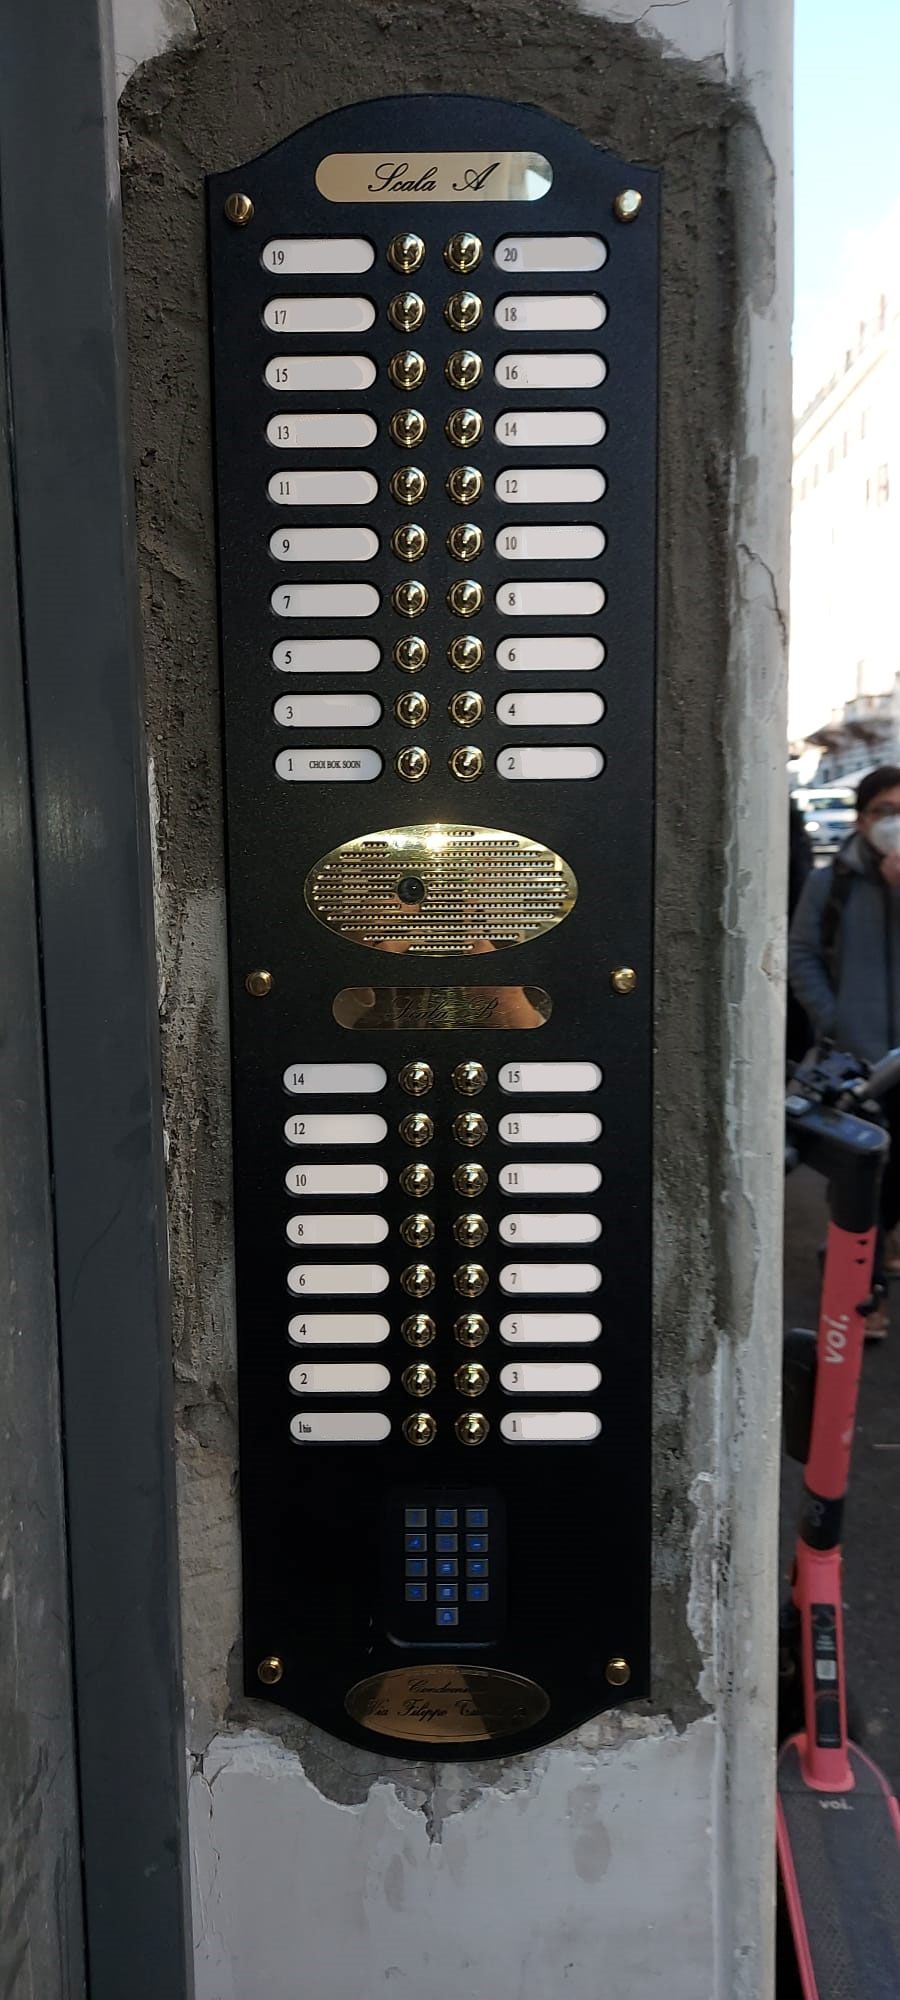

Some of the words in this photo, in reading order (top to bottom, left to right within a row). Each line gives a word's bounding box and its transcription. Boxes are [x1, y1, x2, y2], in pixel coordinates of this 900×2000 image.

[367, 162, 438, 192] Scala
[451, 162, 502, 192] A
[272, 250, 284, 265] 19
[504, 248, 517, 262] 20
[274, 310, 286, 325] 17
[504, 308, 517, 322] 18
[275, 368, 288, 382] 15
[505, 366, 518, 380] 16
[277, 425, 290, 439] 13
[504, 422, 517, 436] 14
[279, 481, 290, 495] 11
[505, 480, 518, 493] 12
[283, 539, 290, 553] 9
[505, 537, 517, 550] 10
[283, 596, 290, 609] 7
[509, 593, 515, 606] 8
[285, 650, 291, 665] 5
[508, 648, 515, 662] 6
[286, 706, 293, 719] 3
[508, 703, 515, 716] 4
[288, 758, 293, 771] 1
[309, 760, 326, 769] CHOI
[327, 760, 341, 769] BOK
[342, 760, 361, 769] SOON
[508, 757, 515, 770] 2
[465, 995, 499, 1022] B
[293, 1073, 304, 1086] 14
[508, 1071, 520, 1083] 15
[294, 1123, 305, 1135] 12
[508, 1122, 519, 1135] 13
[295, 1174, 306, 1187] 10
[508, 1173, 518, 1185] 11
[298, 1224, 304, 1236] 8
[510, 1223, 516, 1235] 9
[299, 1274, 305, 1286] 6
[511, 1273, 516, 1284] 7
[299, 1324, 306, 1336] 4
[511, 1322, 517, 1334] 5
[301, 1373, 307, 1385] 2
[512, 1372, 518, 1384] 3
[512, 1420, 516, 1432] 1
[367, 1697, 391, 1717] Via
[397, 1698, 449, 1722] Filippo
